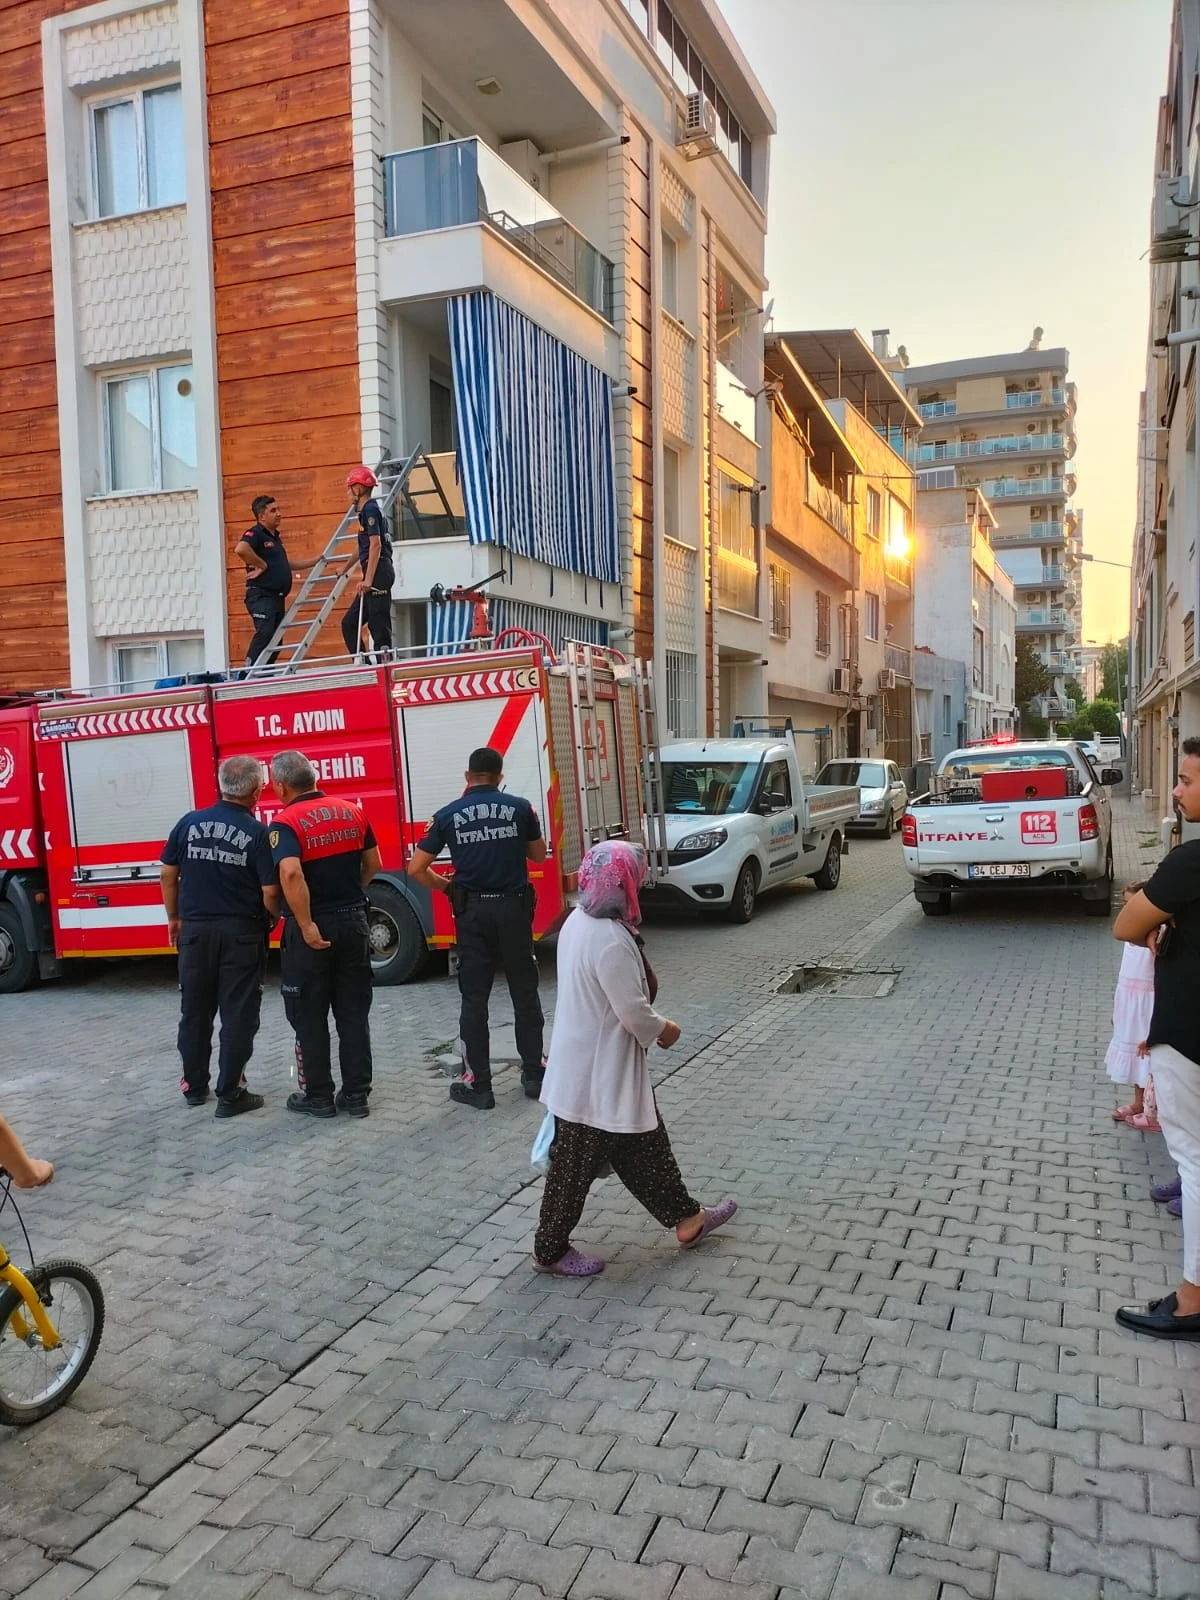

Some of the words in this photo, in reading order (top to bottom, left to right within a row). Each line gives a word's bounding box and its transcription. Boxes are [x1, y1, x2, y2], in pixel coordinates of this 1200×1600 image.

[516, 670, 538, 688] CE
[255, 714, 287, 737] T.C.
[293, 708, 345, 734] AYDIN
[299, 806, 354, 832] AYDIN
[453, 803, 516, 829] AYDIN
[1025, 814, 1052, 831] 112
[187, 821, 253, 850] AYDIN
[455, 821, 518, 845] İTFAİYESİ
[919, 832, 989, 842] İTFAİYE
[187, 842, 248, 867] İTFAİYESİ
[974, 866, 985, 876] 34
[990, 865, 1007, 875] CEJ
[1012, 864, 1029, 875] 793
